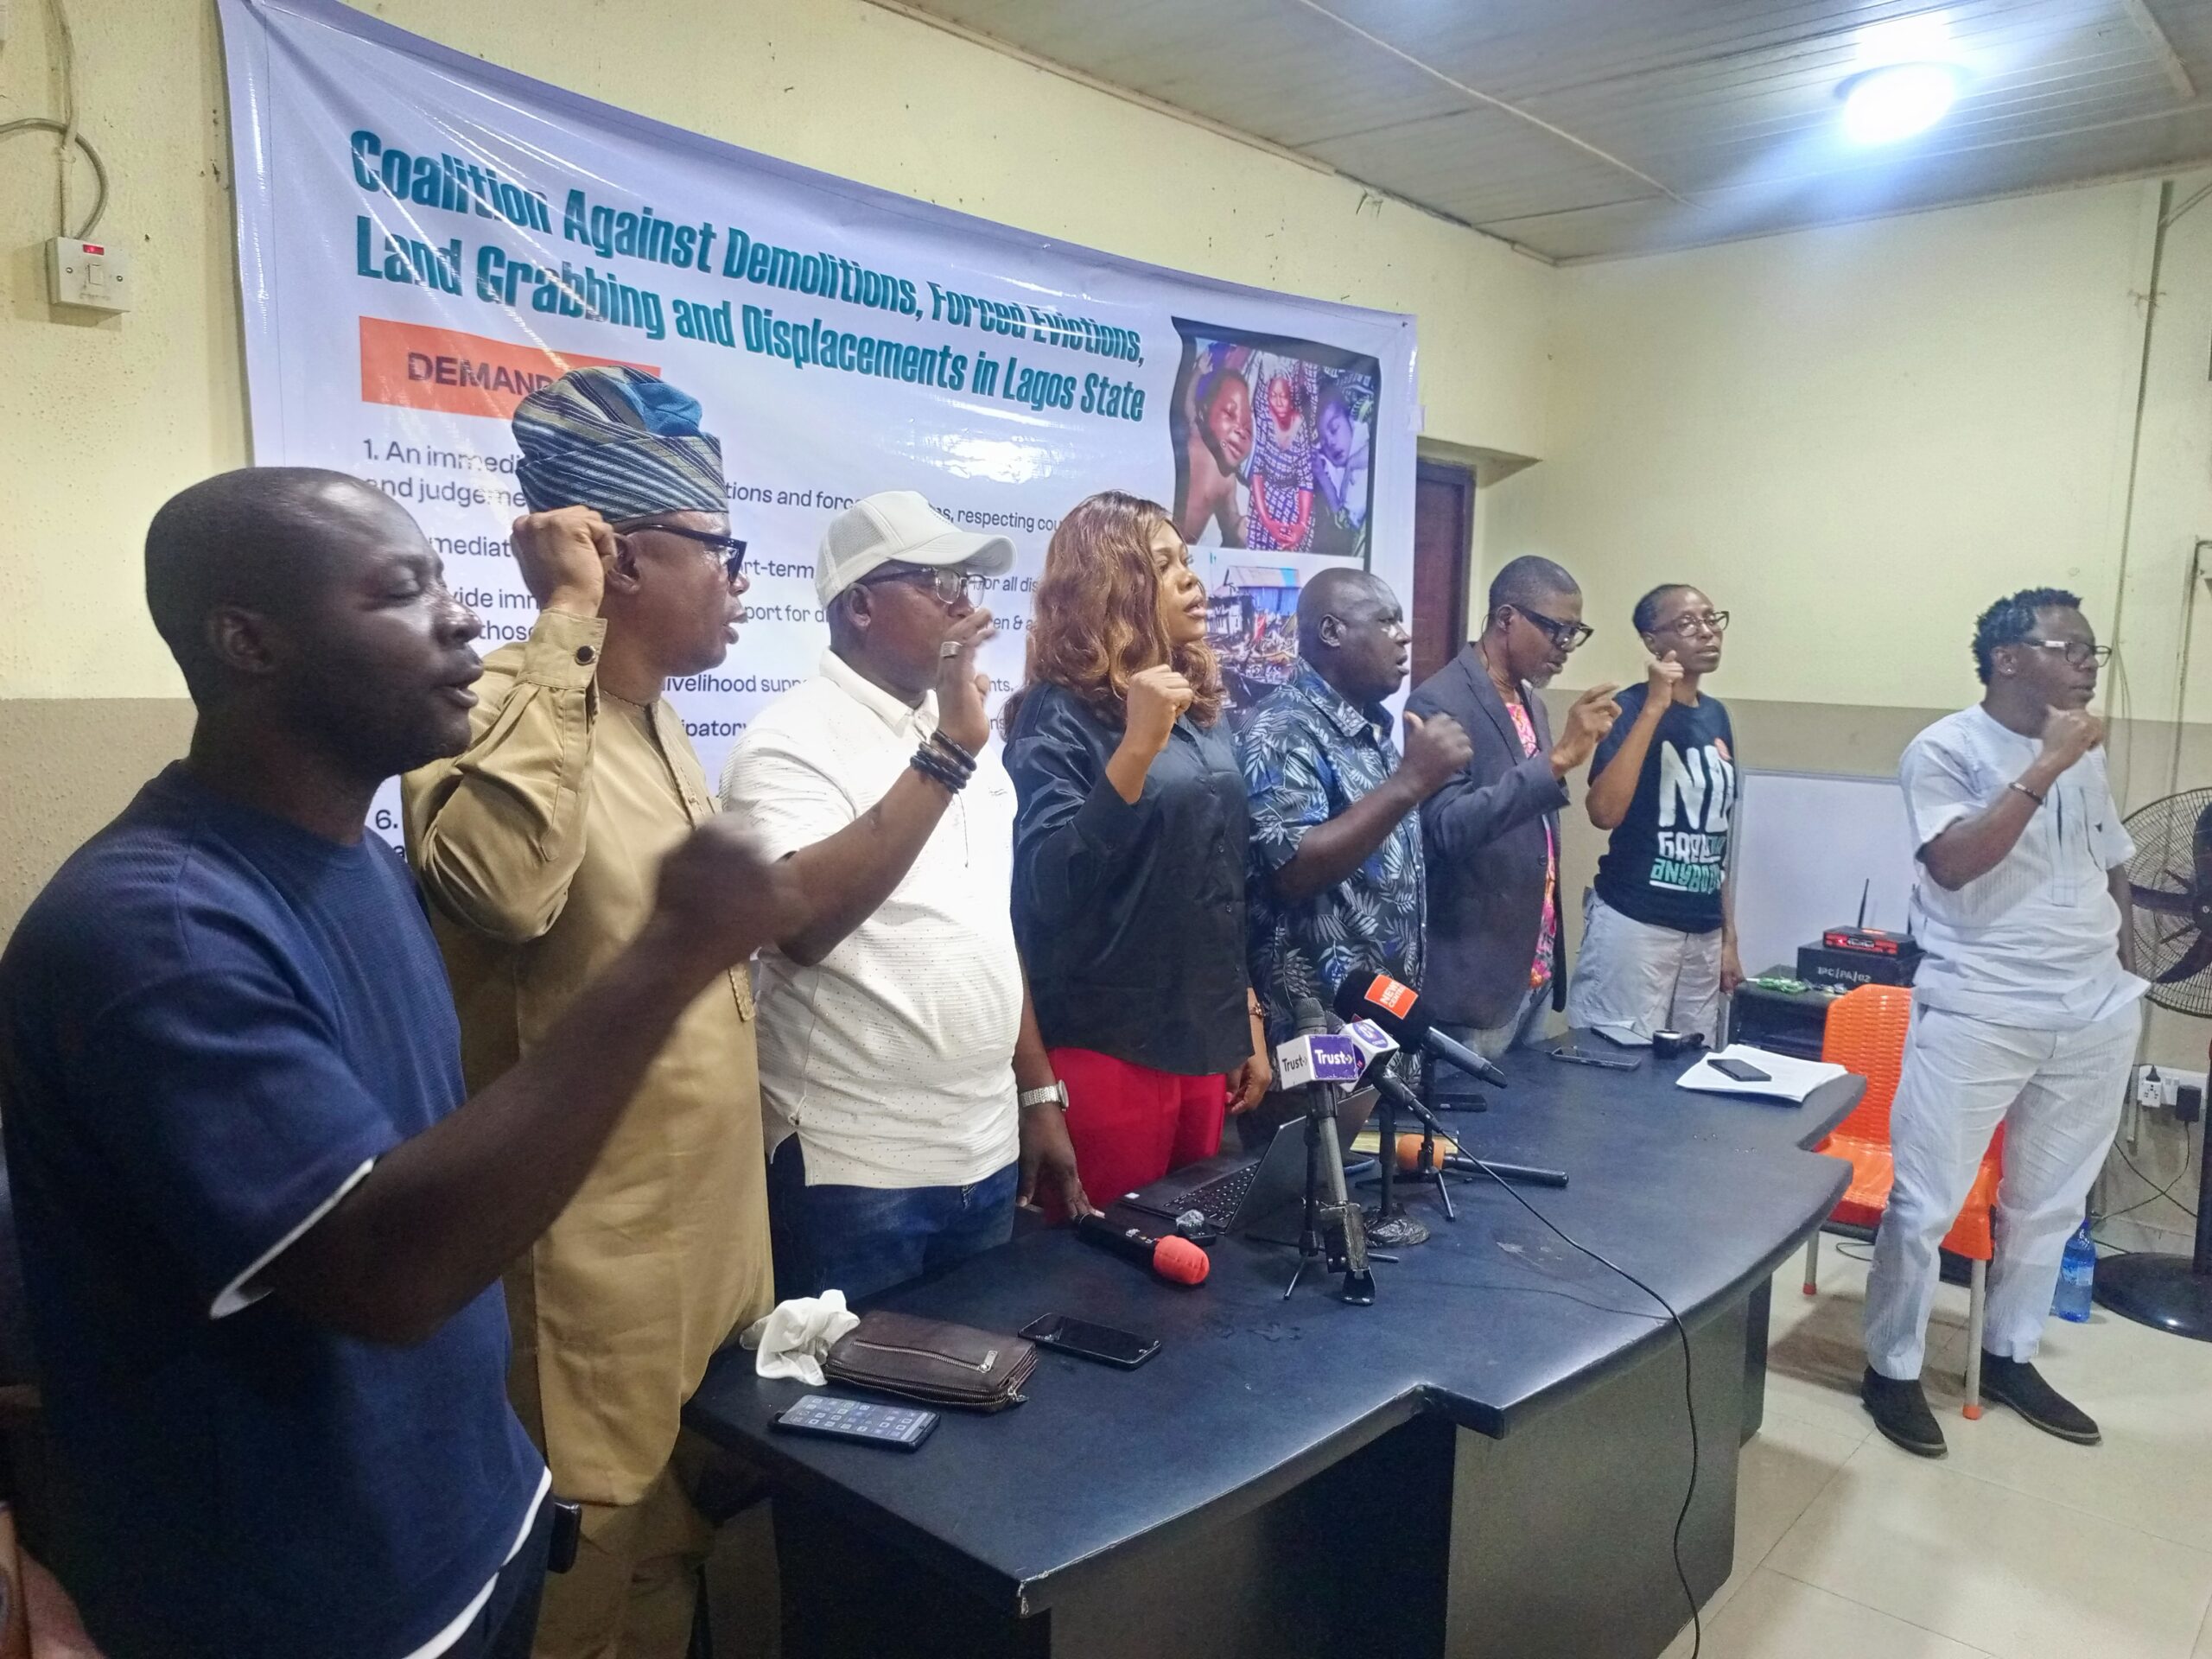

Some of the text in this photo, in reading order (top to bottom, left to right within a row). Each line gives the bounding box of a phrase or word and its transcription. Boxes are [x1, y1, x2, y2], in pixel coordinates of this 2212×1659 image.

[350, 130, 1144, 367] Coalition Against Demolitions, Forced Evictions,
[356, 215, 1146, 423] Land Grabbing and Displacements in Lagos State
[408, 352, 554, 396] DEMAND
[363, 438, 378, 461] 1.
[385, 441, 421, 465] An
[427, 445, 520, 474] immedi
[725, 481, 772, 504] tions
[777, 489, 812, 507] and
[816, 491, 861, 510] forc
[957, 509, 1035, 533] respecting
[418, 478, 526, 508] judgeme
[429, 536, 511, 557] mediat
[743, 559, 814, 579] rt-term
[1002, 576, 1018, 592] all
[785, 605, 810, 622] for
[664, 674, 757, 692] ivelihood
[376, 809, 398, 830] 6.
[1281, 1054, 1303, 1072] Trust
[1314, 1049, 1346, 1065] Trust
